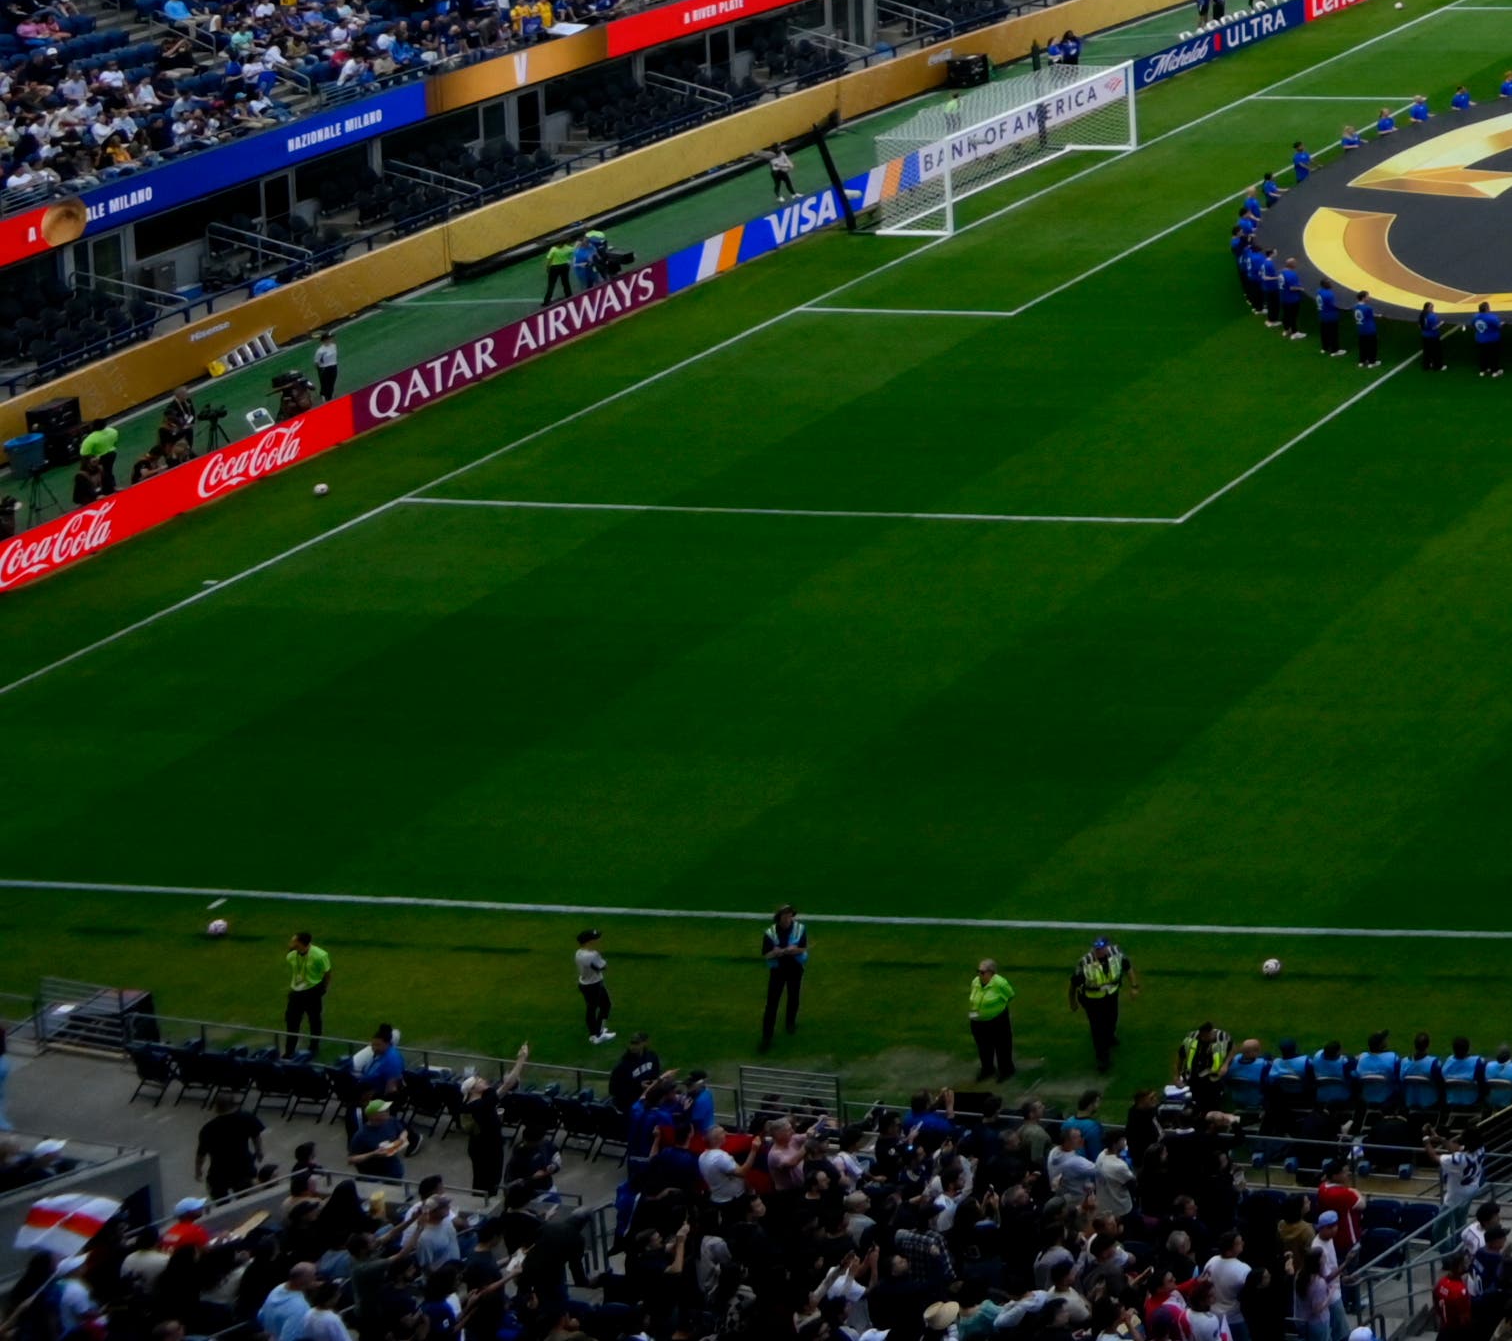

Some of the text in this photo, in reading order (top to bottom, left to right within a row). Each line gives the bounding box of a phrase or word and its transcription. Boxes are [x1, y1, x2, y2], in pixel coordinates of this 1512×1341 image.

[684, 12, 690, 24] A
[692, 4, 717, 21] RIVER
[514, 52, 528, 85] V
[1141, 7, 1287, 84] Michelob ULTRA
[288, 109, 382, 152] NAZIONALE MILANO
[922, 85, 1100, 175] BANK OF AMERICA
[764, 188, 839, 247] VISA
[188, 320, 231, 343] Hisense
[367, 265, 657, 420] QATAR AIRWAYS
[196, 419, 305, 501] Coca-Cola
